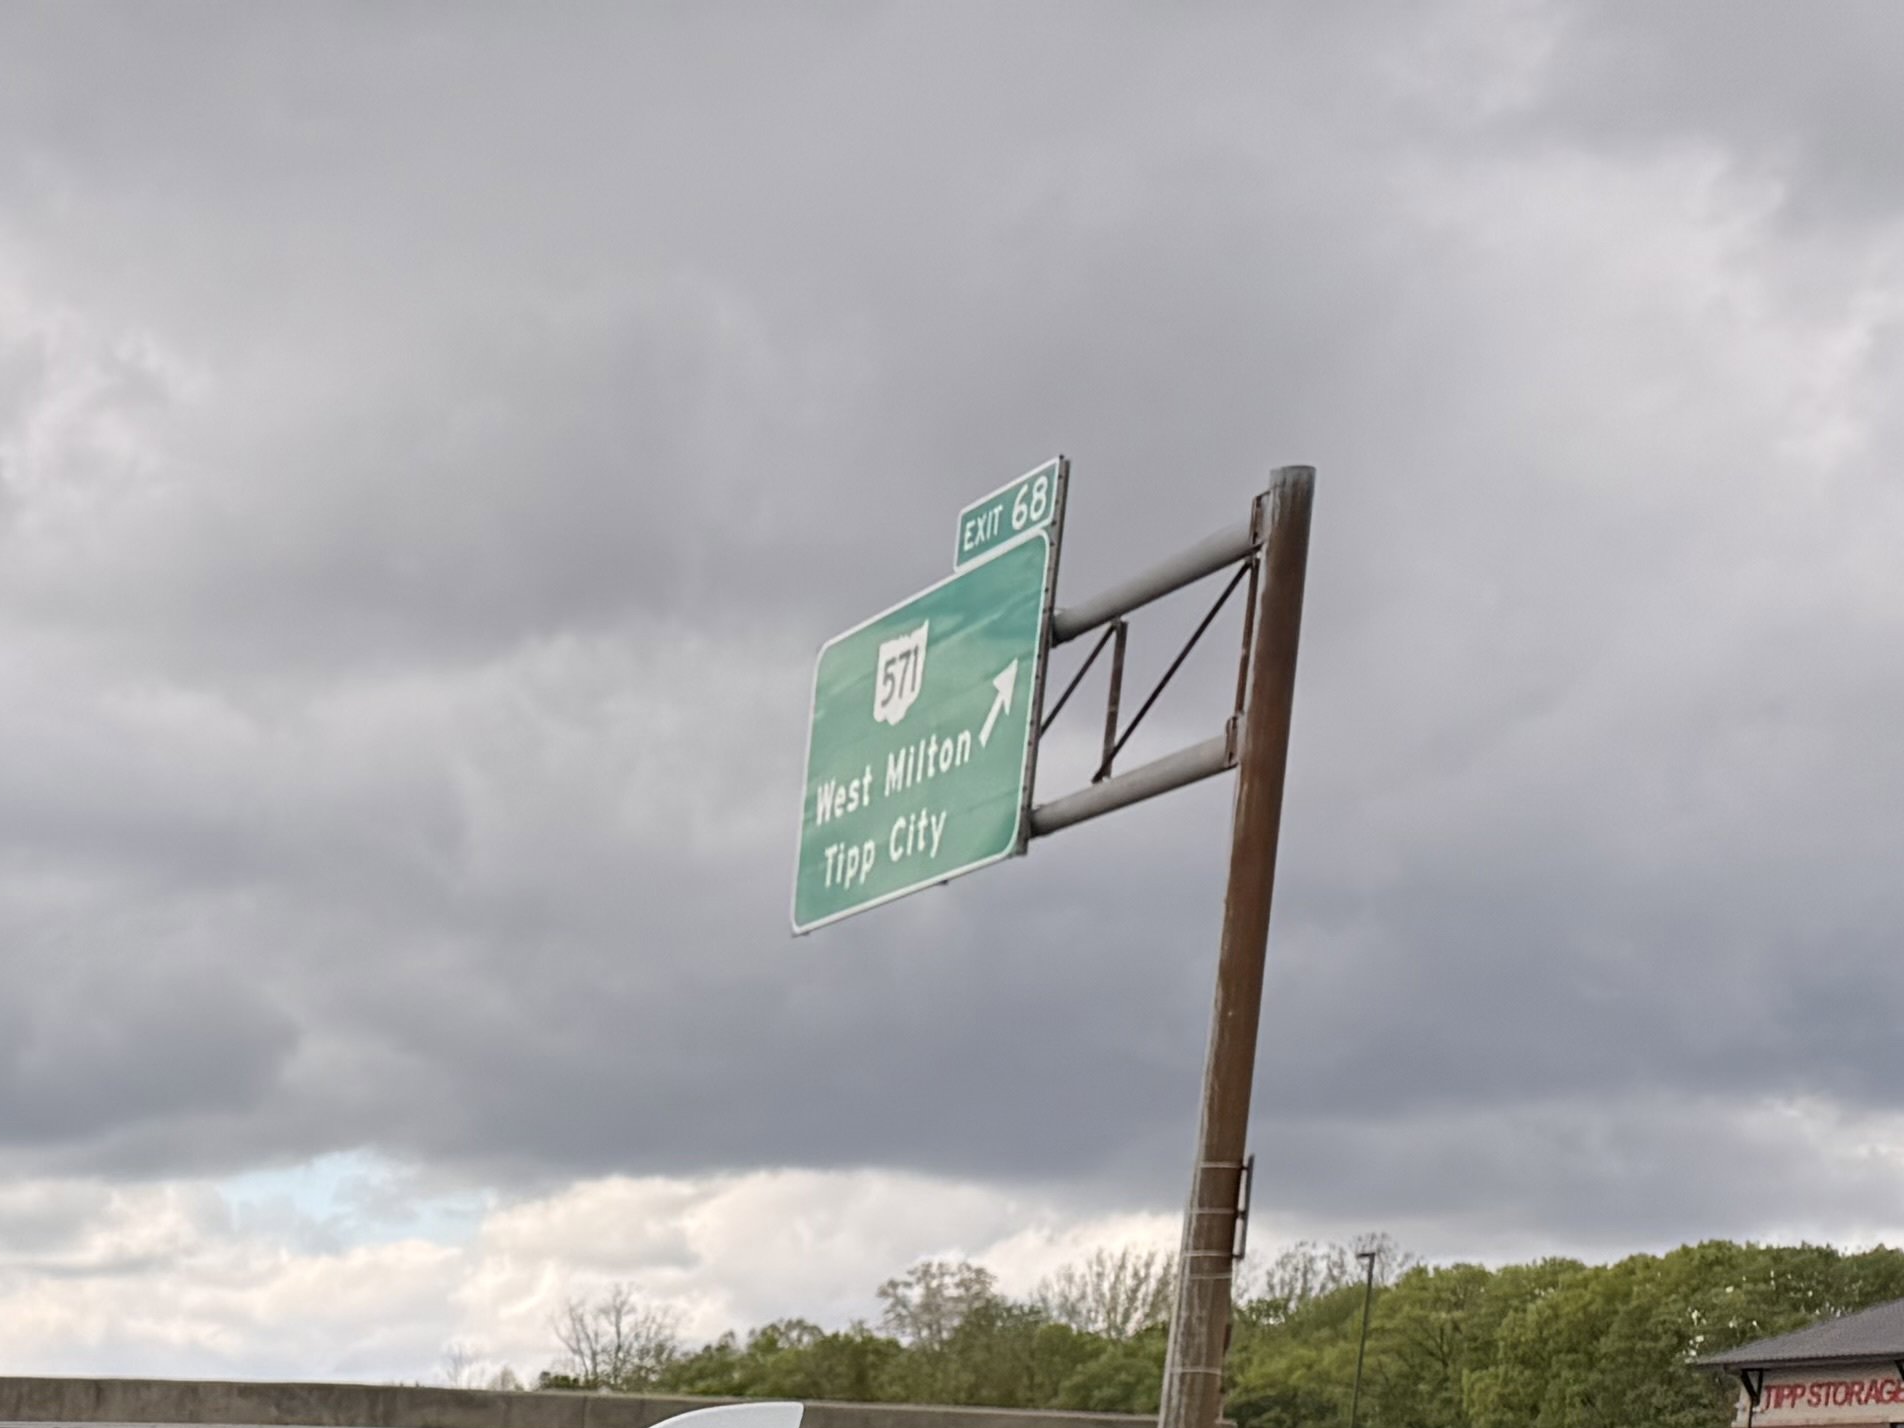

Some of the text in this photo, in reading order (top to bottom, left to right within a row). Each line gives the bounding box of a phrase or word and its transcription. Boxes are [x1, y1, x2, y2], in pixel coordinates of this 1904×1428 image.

[963, 475, 1048, 552] EXIT 68
[880, 642, 920, 709] 571
[816, 729, 972, 826] West Milton
[823, 807, 948, 891] Tipp City
[1764, 1384, 1807, 1410] TIPP
